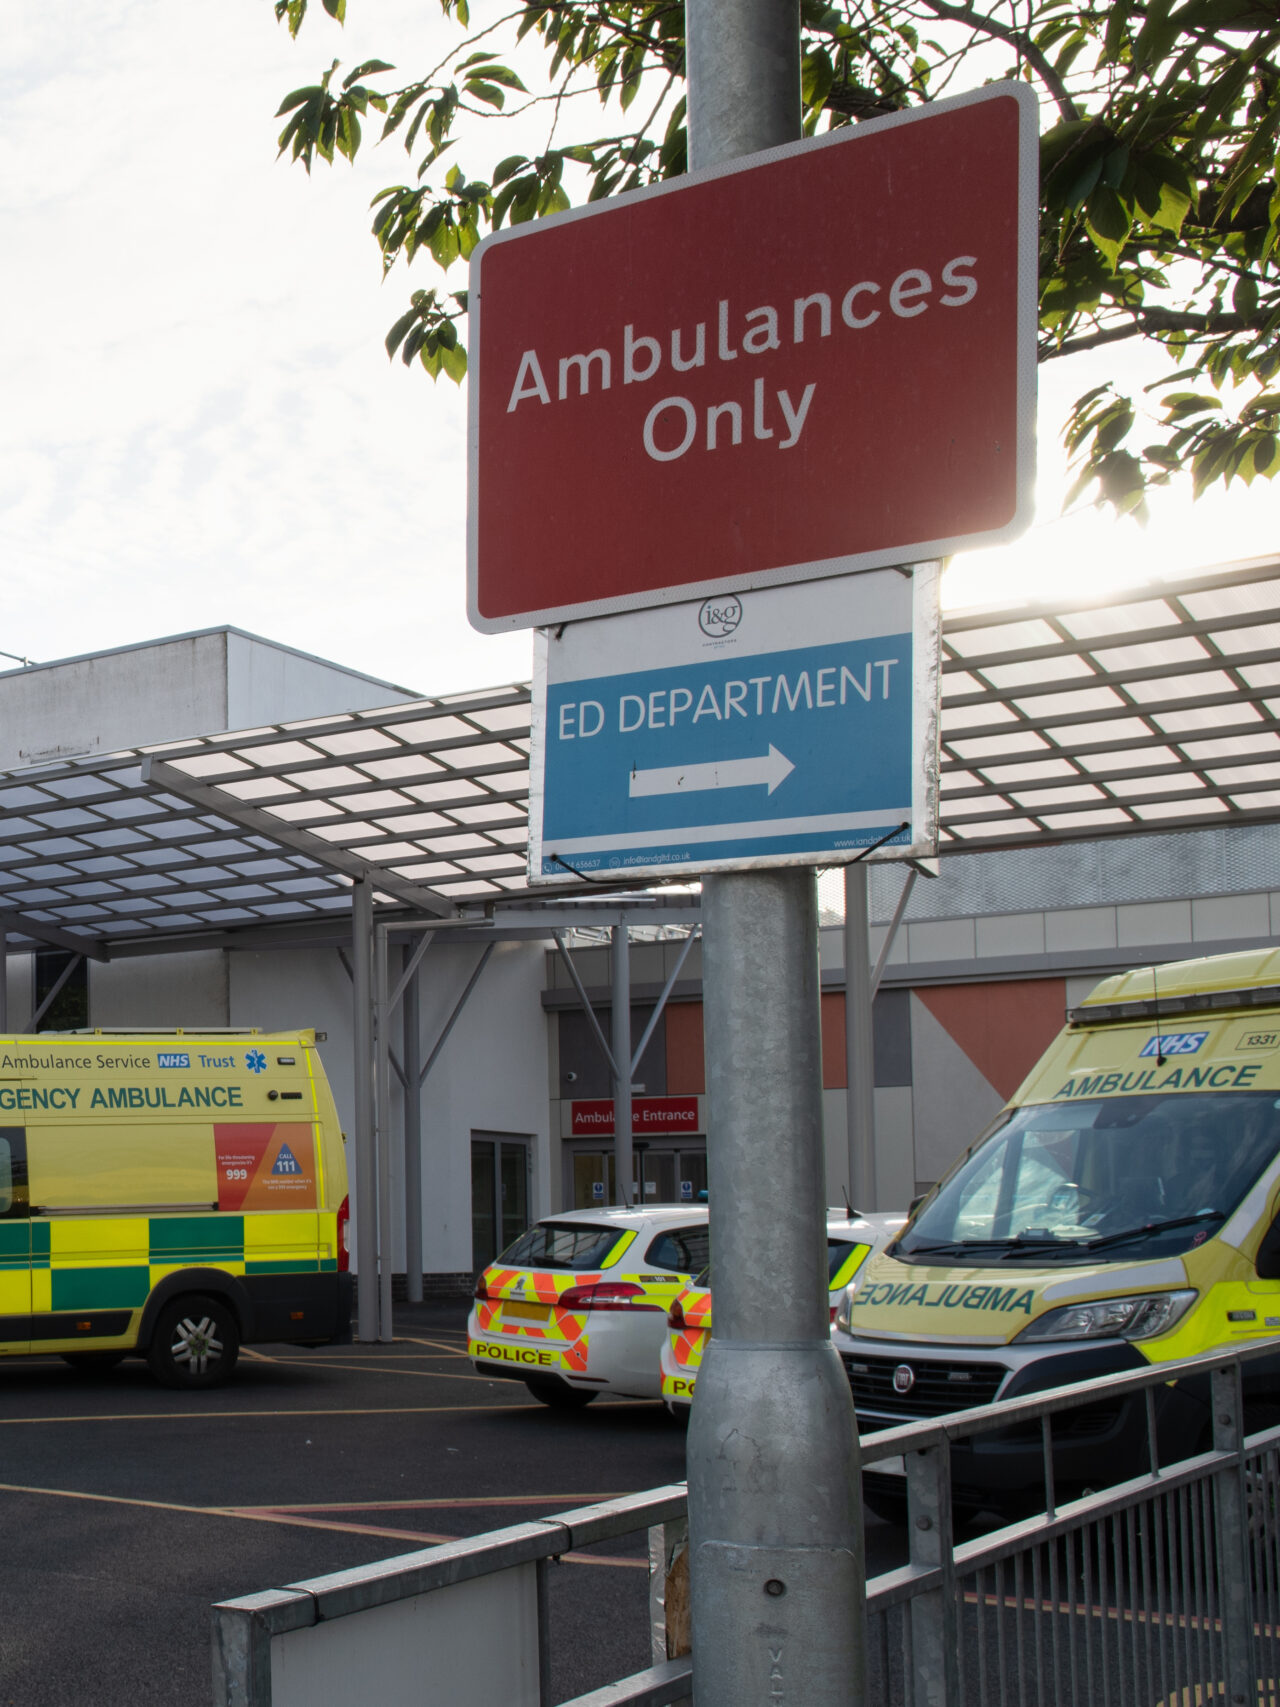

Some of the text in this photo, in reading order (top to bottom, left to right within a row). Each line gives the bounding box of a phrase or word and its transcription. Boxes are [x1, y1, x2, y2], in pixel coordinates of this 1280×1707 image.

[507, 256, 978, 413] Ambulances
[643, 378, 817, 462] Only
[559, 659, 900, 741] ED DEPARTMENT
[1143, 1033, 1206, 1057] NHS
[1247, 1033, 1277, 1046] 1331
[1, 1053, 91, 1069] Ambulance
[97, 1053, 151, 1069] Service
[159, 1054, 190, 1068] NHS
[198, 1054, 236, 1068] Trust
[1052, 1064, 1263, 1099] AMBULANCE
[90, 1086, 243, 1109] AMBULANCE
[575, 1109, 695, 1123] Ambule Entrance
[226, 1169, 247, 1180] 999
[276, 1160, 296, 1172] 111
[476, 1344, 552, 1366] POLICE
